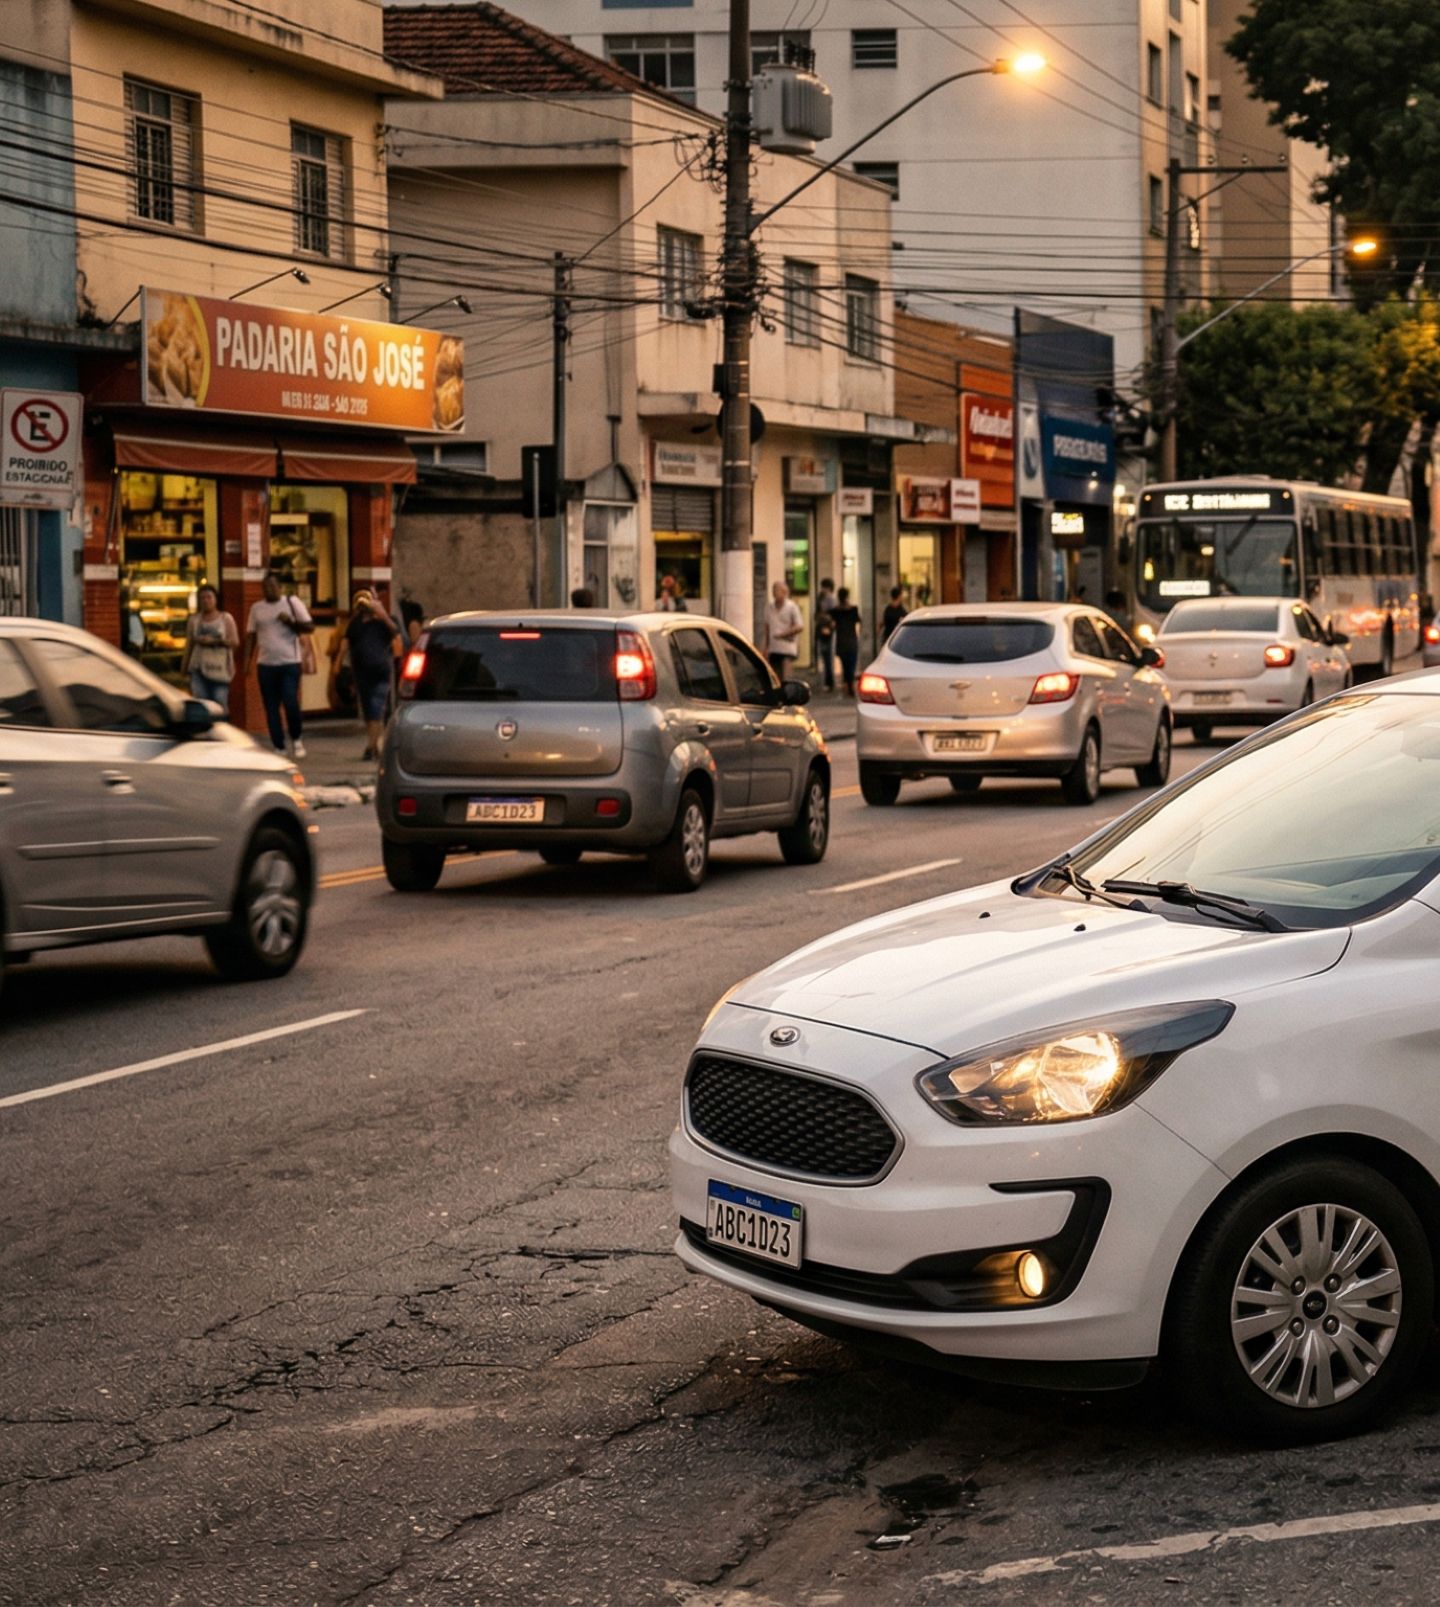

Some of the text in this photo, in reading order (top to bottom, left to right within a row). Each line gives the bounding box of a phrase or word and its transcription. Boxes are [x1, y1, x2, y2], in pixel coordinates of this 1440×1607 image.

[216, 317, 425, 390] PADARIA SÃO JOSÉ
[475, 804, 537, 820] ABC1D23
[715, 1204, 791, 1257] ABC1D23
